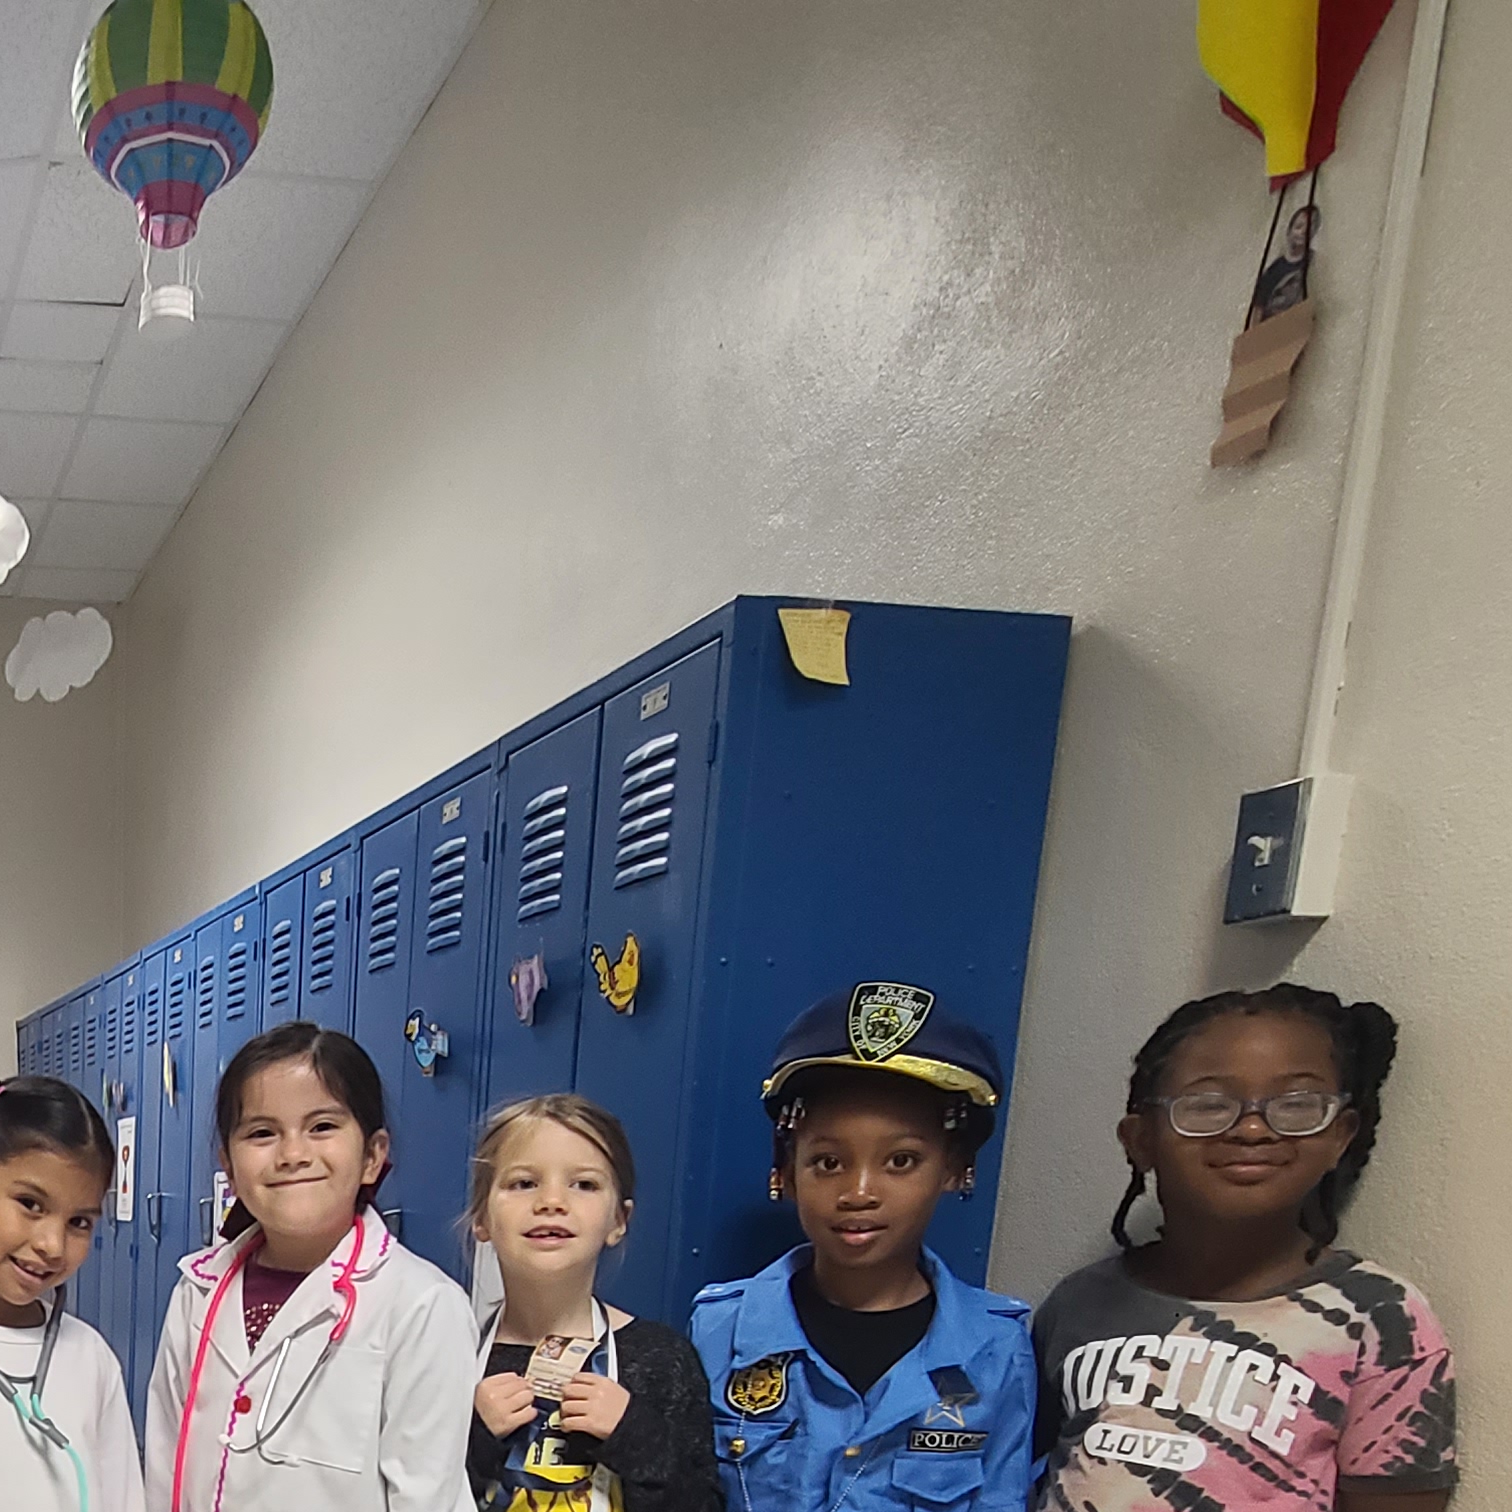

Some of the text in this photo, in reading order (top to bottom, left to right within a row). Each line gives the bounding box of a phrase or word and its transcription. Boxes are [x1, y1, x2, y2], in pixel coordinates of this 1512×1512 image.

[859, 994, 926, 1013] DEPARTMENT
[876, 986, 916, 999] POLICE
[851, 1016, 867, 1050] CITY OF
[877, 1019, 921, 1057] NEW YORK
[1063, 1334, 1316, 1456] JUSTICE
[913, 1432, 979, 1447] POLICE
[1095, 1428, 1190, 1465] LOVE
